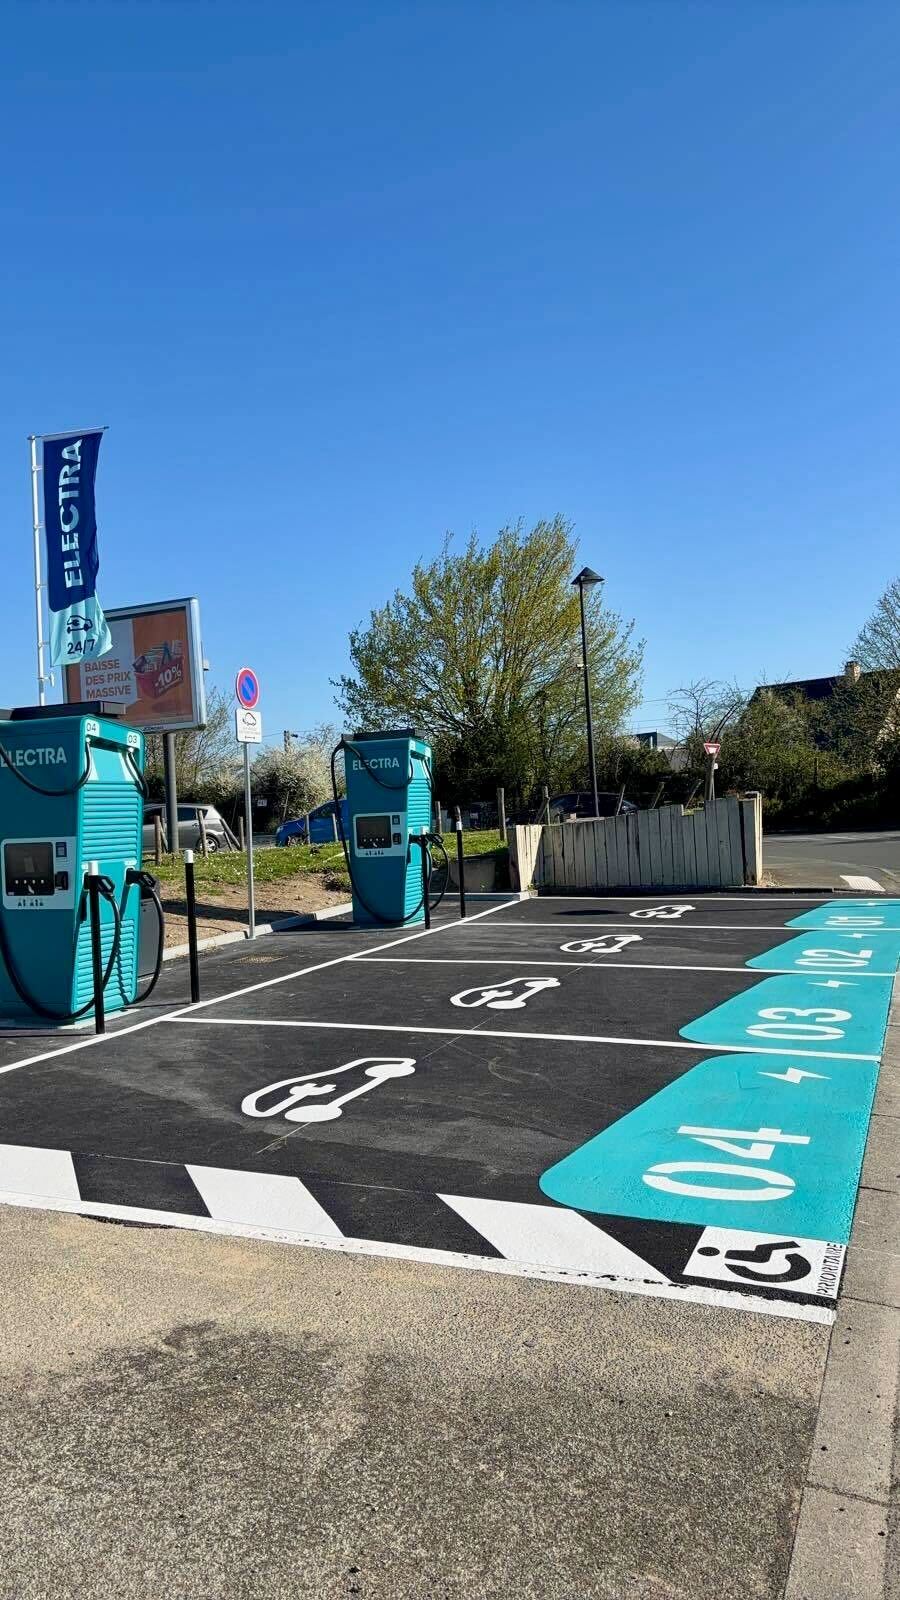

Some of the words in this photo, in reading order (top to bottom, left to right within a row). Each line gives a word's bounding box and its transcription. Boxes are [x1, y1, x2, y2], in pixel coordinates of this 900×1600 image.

[58, 438, 84, 589] ELECTRA
[67, 638, 95, 655] 24/7
[84, 659, 120, 673] BAISSE
[85, 674, 105, 686] DES
[107, 671, 132, 683] PRIX
[154, 663, 182, 687] -10%
[86, 685, 132, 699] MASSIVE
[86, 723, 97, 732] 04
[128, 734, 138, 744] 03
[794, 949, 873, 968] 02
[745, 1007, 852, 1041] 03
[642, 1125, 812, 1202] 04
